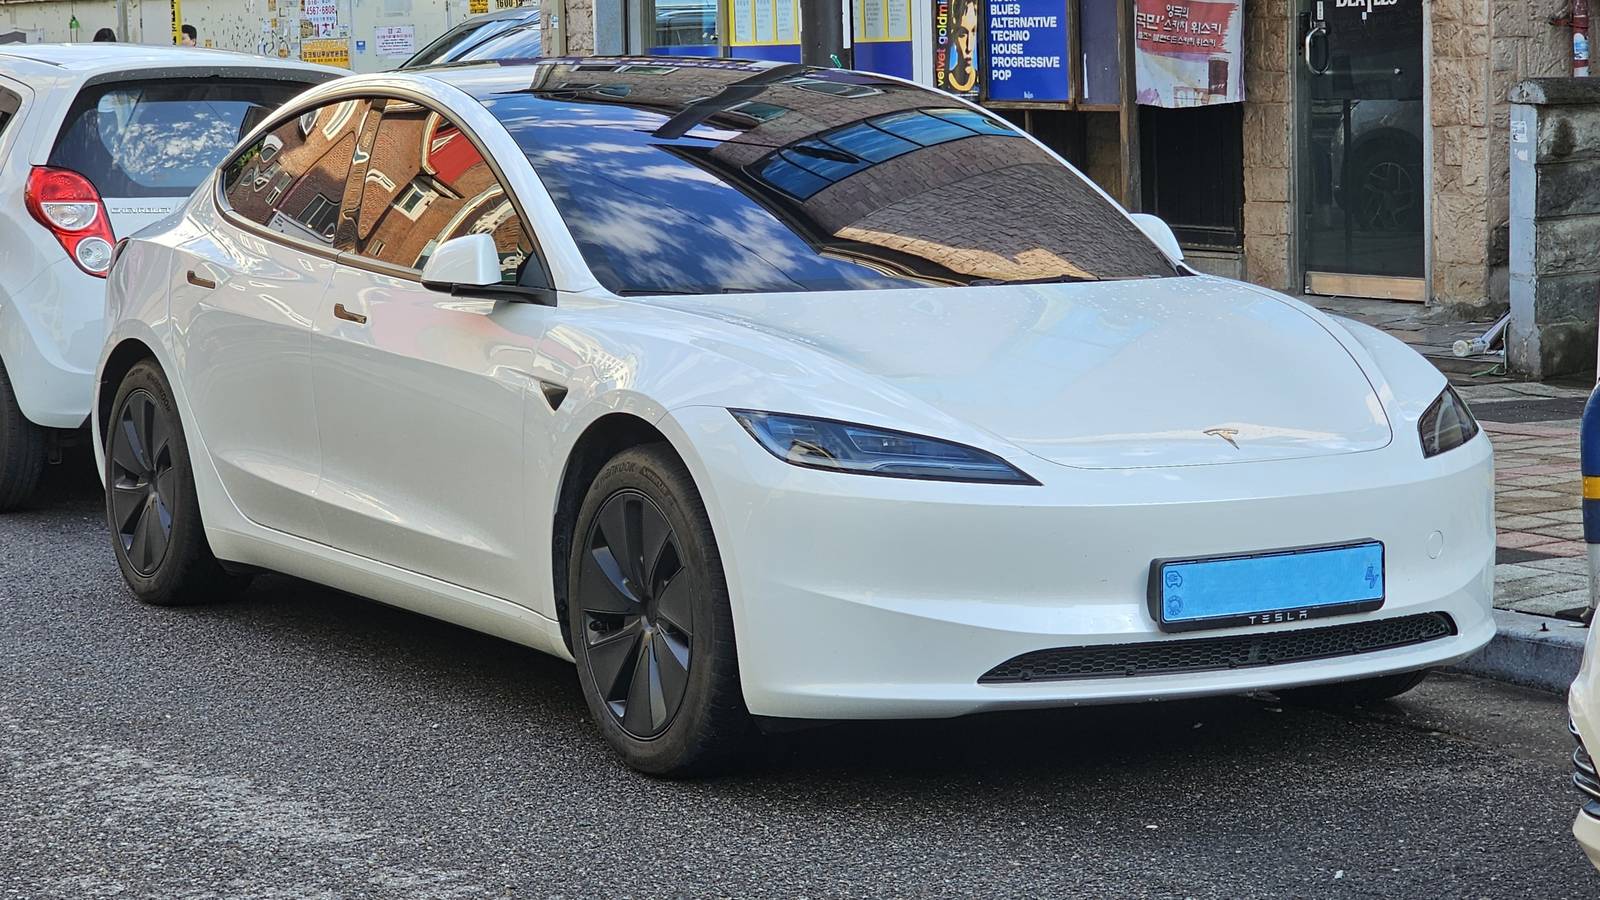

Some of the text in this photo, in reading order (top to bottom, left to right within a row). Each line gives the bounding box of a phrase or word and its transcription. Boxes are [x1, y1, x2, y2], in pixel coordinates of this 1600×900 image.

[990, 4, 1021, 15] BLUES
[991, 16, 1057, 28] ALTERNATIVE
[1191, 21, 1222, 35] 위스키
[991, 30, 1030, 41] TECHNO
[935, 0, 949, 87] velvet goldmi
[991, 43, 1023, 54] HOUSE
[992, 57, 1060, 68] PROGRESSIVE
[992, 70, 1012, 80] POP
[1248, 610, 1308, 625] TESLA
